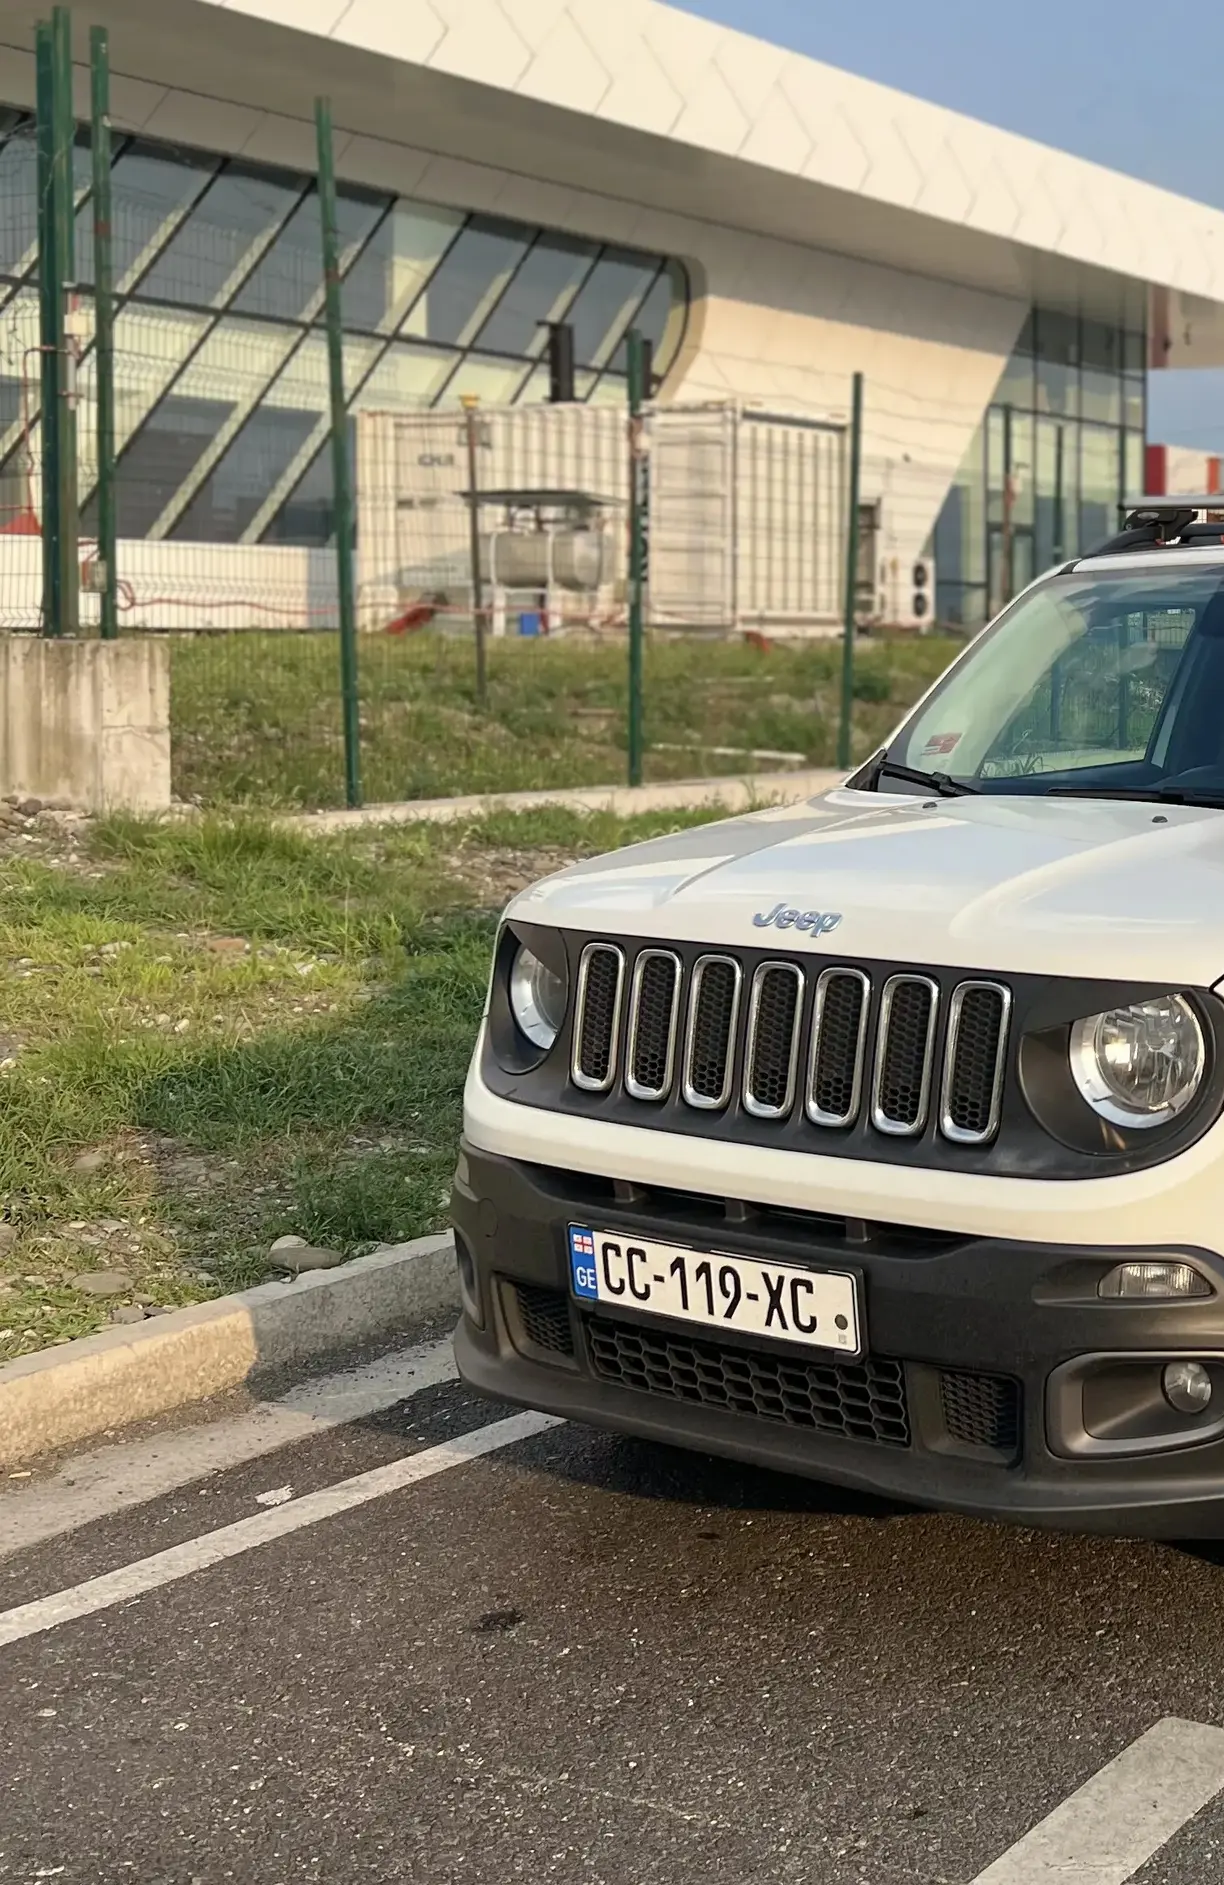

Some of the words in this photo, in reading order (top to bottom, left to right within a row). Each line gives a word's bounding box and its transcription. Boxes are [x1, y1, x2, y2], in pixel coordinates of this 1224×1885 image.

[752, 902, 842, 938] Jeep
[576, 1266, 597, 1290] GE
[601, 1242, 818, 1334] CC-119-XC
